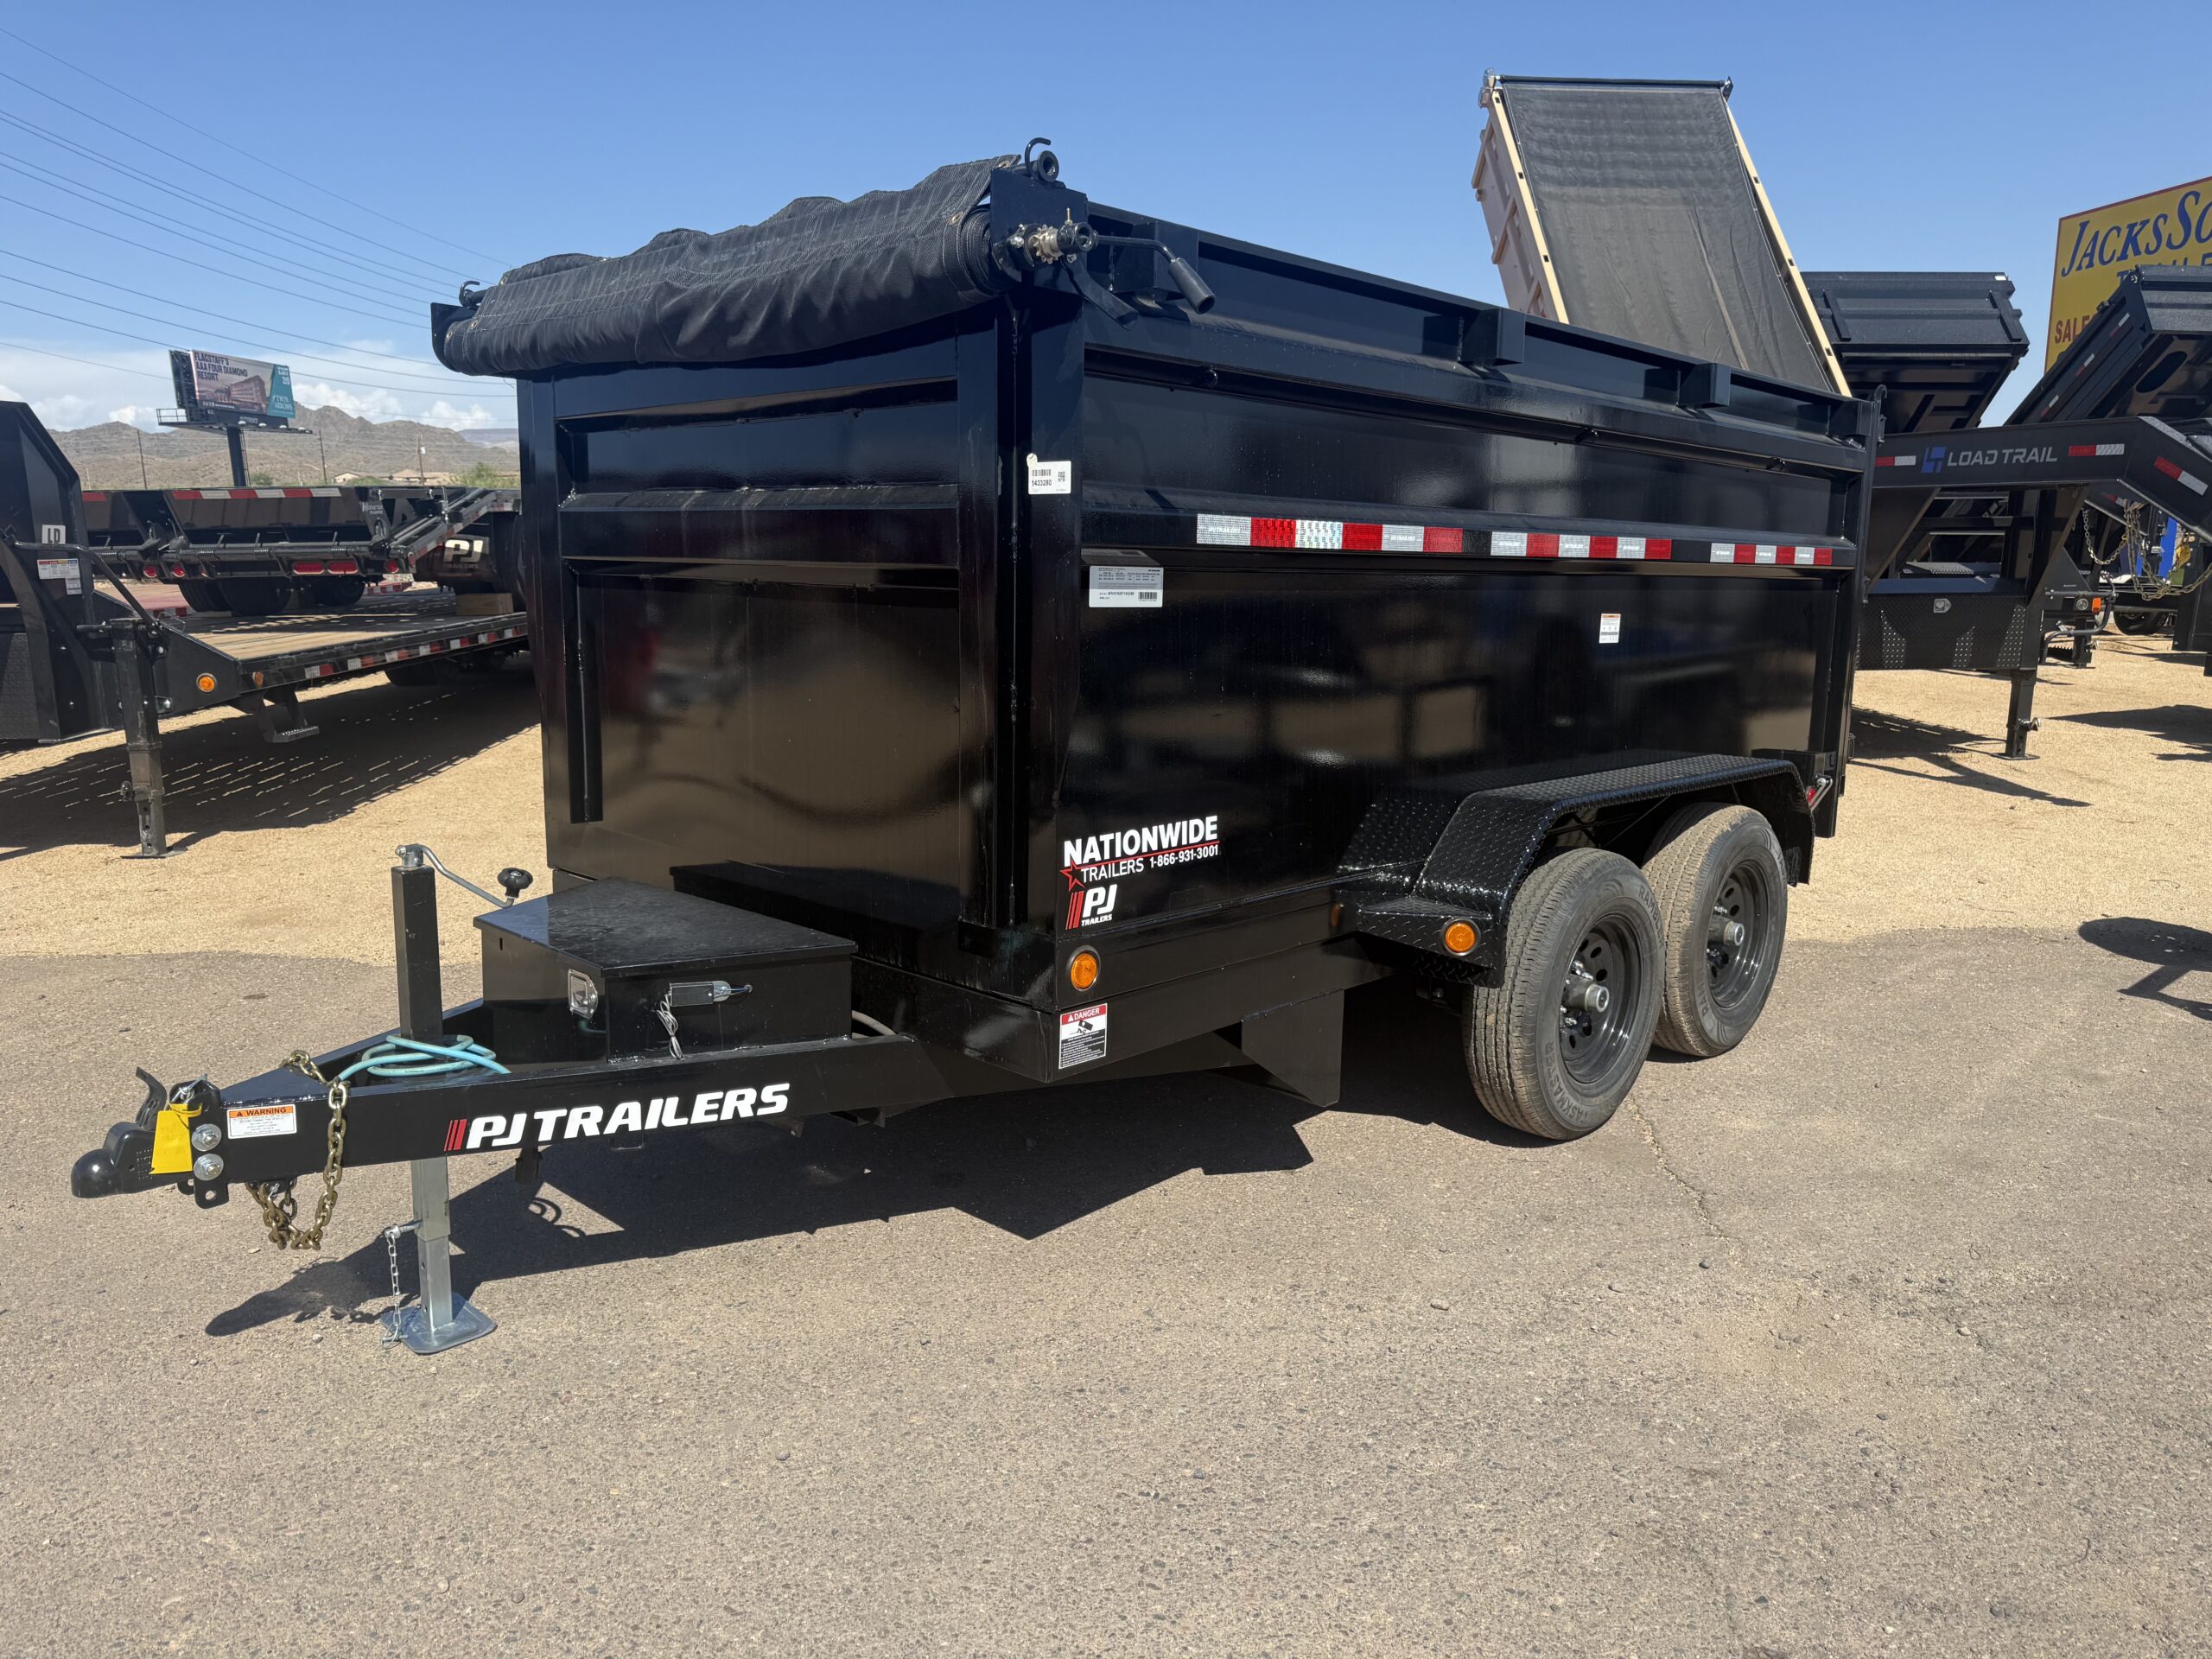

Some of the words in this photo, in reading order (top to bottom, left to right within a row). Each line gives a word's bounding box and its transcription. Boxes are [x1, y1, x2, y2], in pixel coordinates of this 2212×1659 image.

[197, 371, 219, 381] RESORT
[207, 363, 223, 373] FOUR
[223, 365, 248, 378] DIAMOND
[1948, 449, 1999, 467] LOAD
[2001, 446, 2058, 465] TRAIL
[443, 539, 484, 563] PJ
[1064, 815, 1218, 868] NATIONWIDE
[1081, 857, 1144, 883] TRAILERS
[1149, 844, 1219, 868] 1-866-931-3001
[1083, 884, 1117, 918] PJ
[1081, 913, 1113, 927] TRAILERS
[1074, 1007, 1100, 1020] DANGER
[246, 1107, 287, 1116] WARNING
[466, 1113, 527, 1149] PJ
[533, 1083, 790, 1142] TRAILERS
